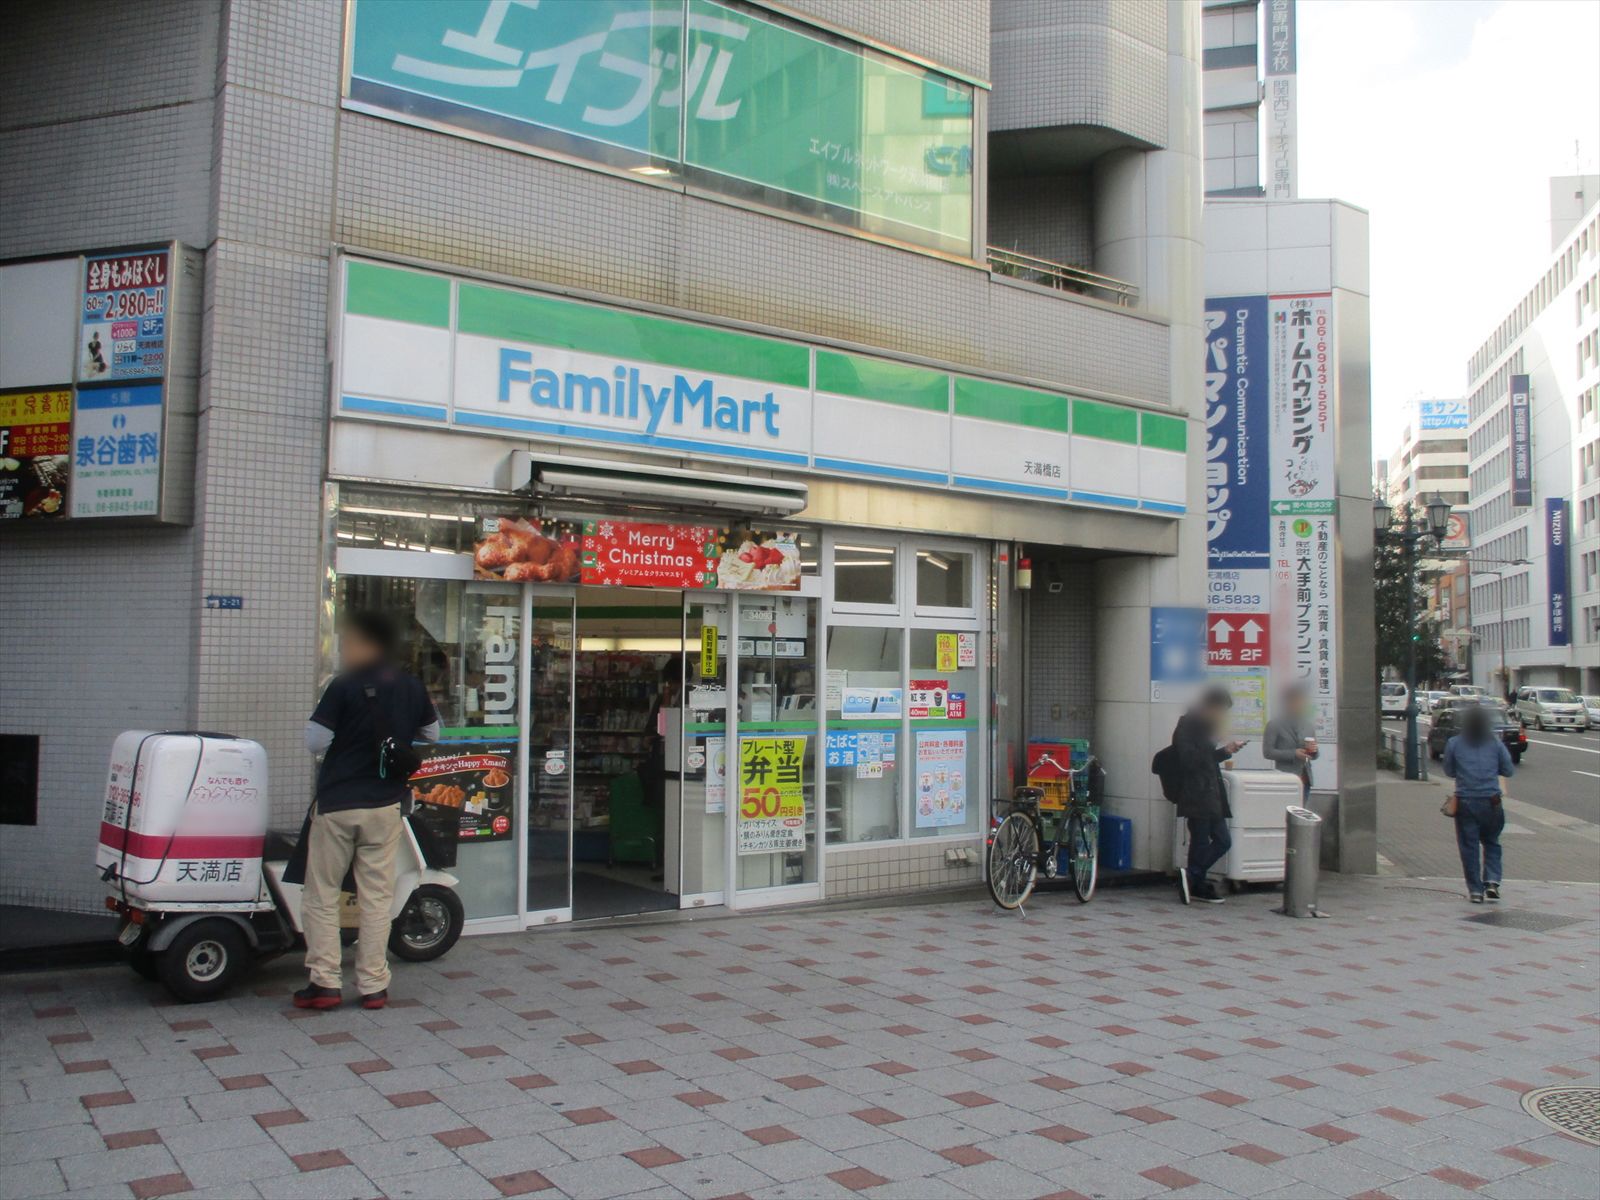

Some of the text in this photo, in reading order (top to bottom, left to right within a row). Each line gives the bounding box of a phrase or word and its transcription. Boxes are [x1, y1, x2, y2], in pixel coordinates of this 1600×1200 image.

[89, 257, 165, 290] 全身もみほぐし
[500, 347, 779, 438] FamilyMart
[1236, 309, 1251, 485] Dramatic Communication
[77, 432, 158, 466] 泉谷歯科
[1024, 461, 1061, 478] 天満橋店
[1552, 510, 1562, 545] MIZUHO
[628, 530, 675, 550] Merry
[608, 548, 693, 567] Christmas
[1208, 582, 1237, 592] (06)
[1240, 648, 1262, 661] 2F
[911, 693, 927, 702] 紅茶
[743, 740, 795, 755] プレート型
[826, 735, 857, 748] たばこ
[828, 751, 854, 765] お酒
[743, 755, 800, 785] 弁当
[742, 787, 781, 818] 50
[780, 806, 803, 817] 円引き
[176, 860, 244, 882] 天満店
